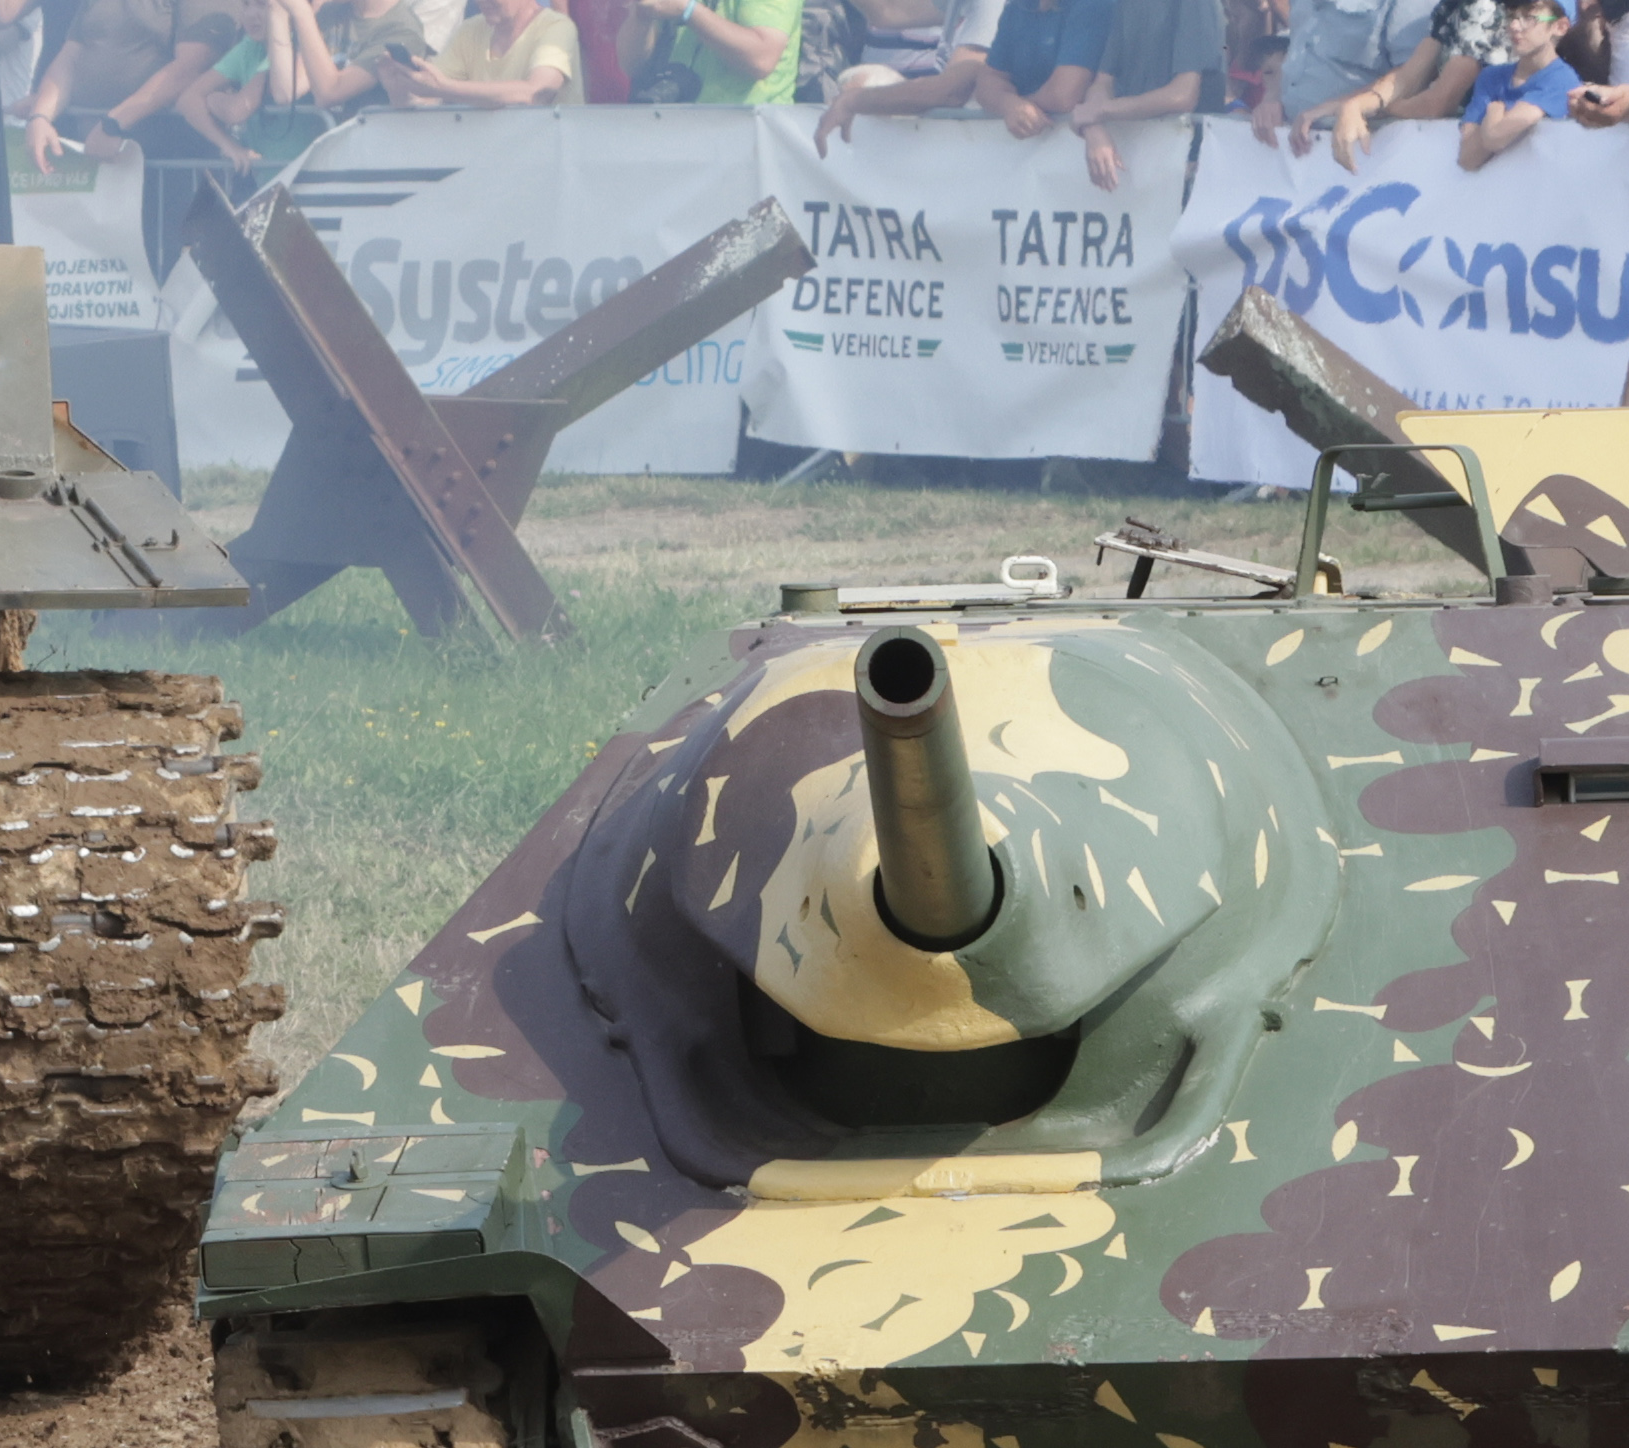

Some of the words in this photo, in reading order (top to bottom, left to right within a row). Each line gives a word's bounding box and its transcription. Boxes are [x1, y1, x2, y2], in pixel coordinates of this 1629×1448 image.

[803, 201, 942, 262] TATRA
[992, 209, 1135, 267] TATRA
[47, 299, 140, 320] OJIŠŤOVNA
[792, 276, 944, 319] DEFENCE
[997, 285, 1133, 325] DEFENCE
[832, 332, 912, 358] VEHICLE
[1027, 341, 1101, 366] VEHICLE
